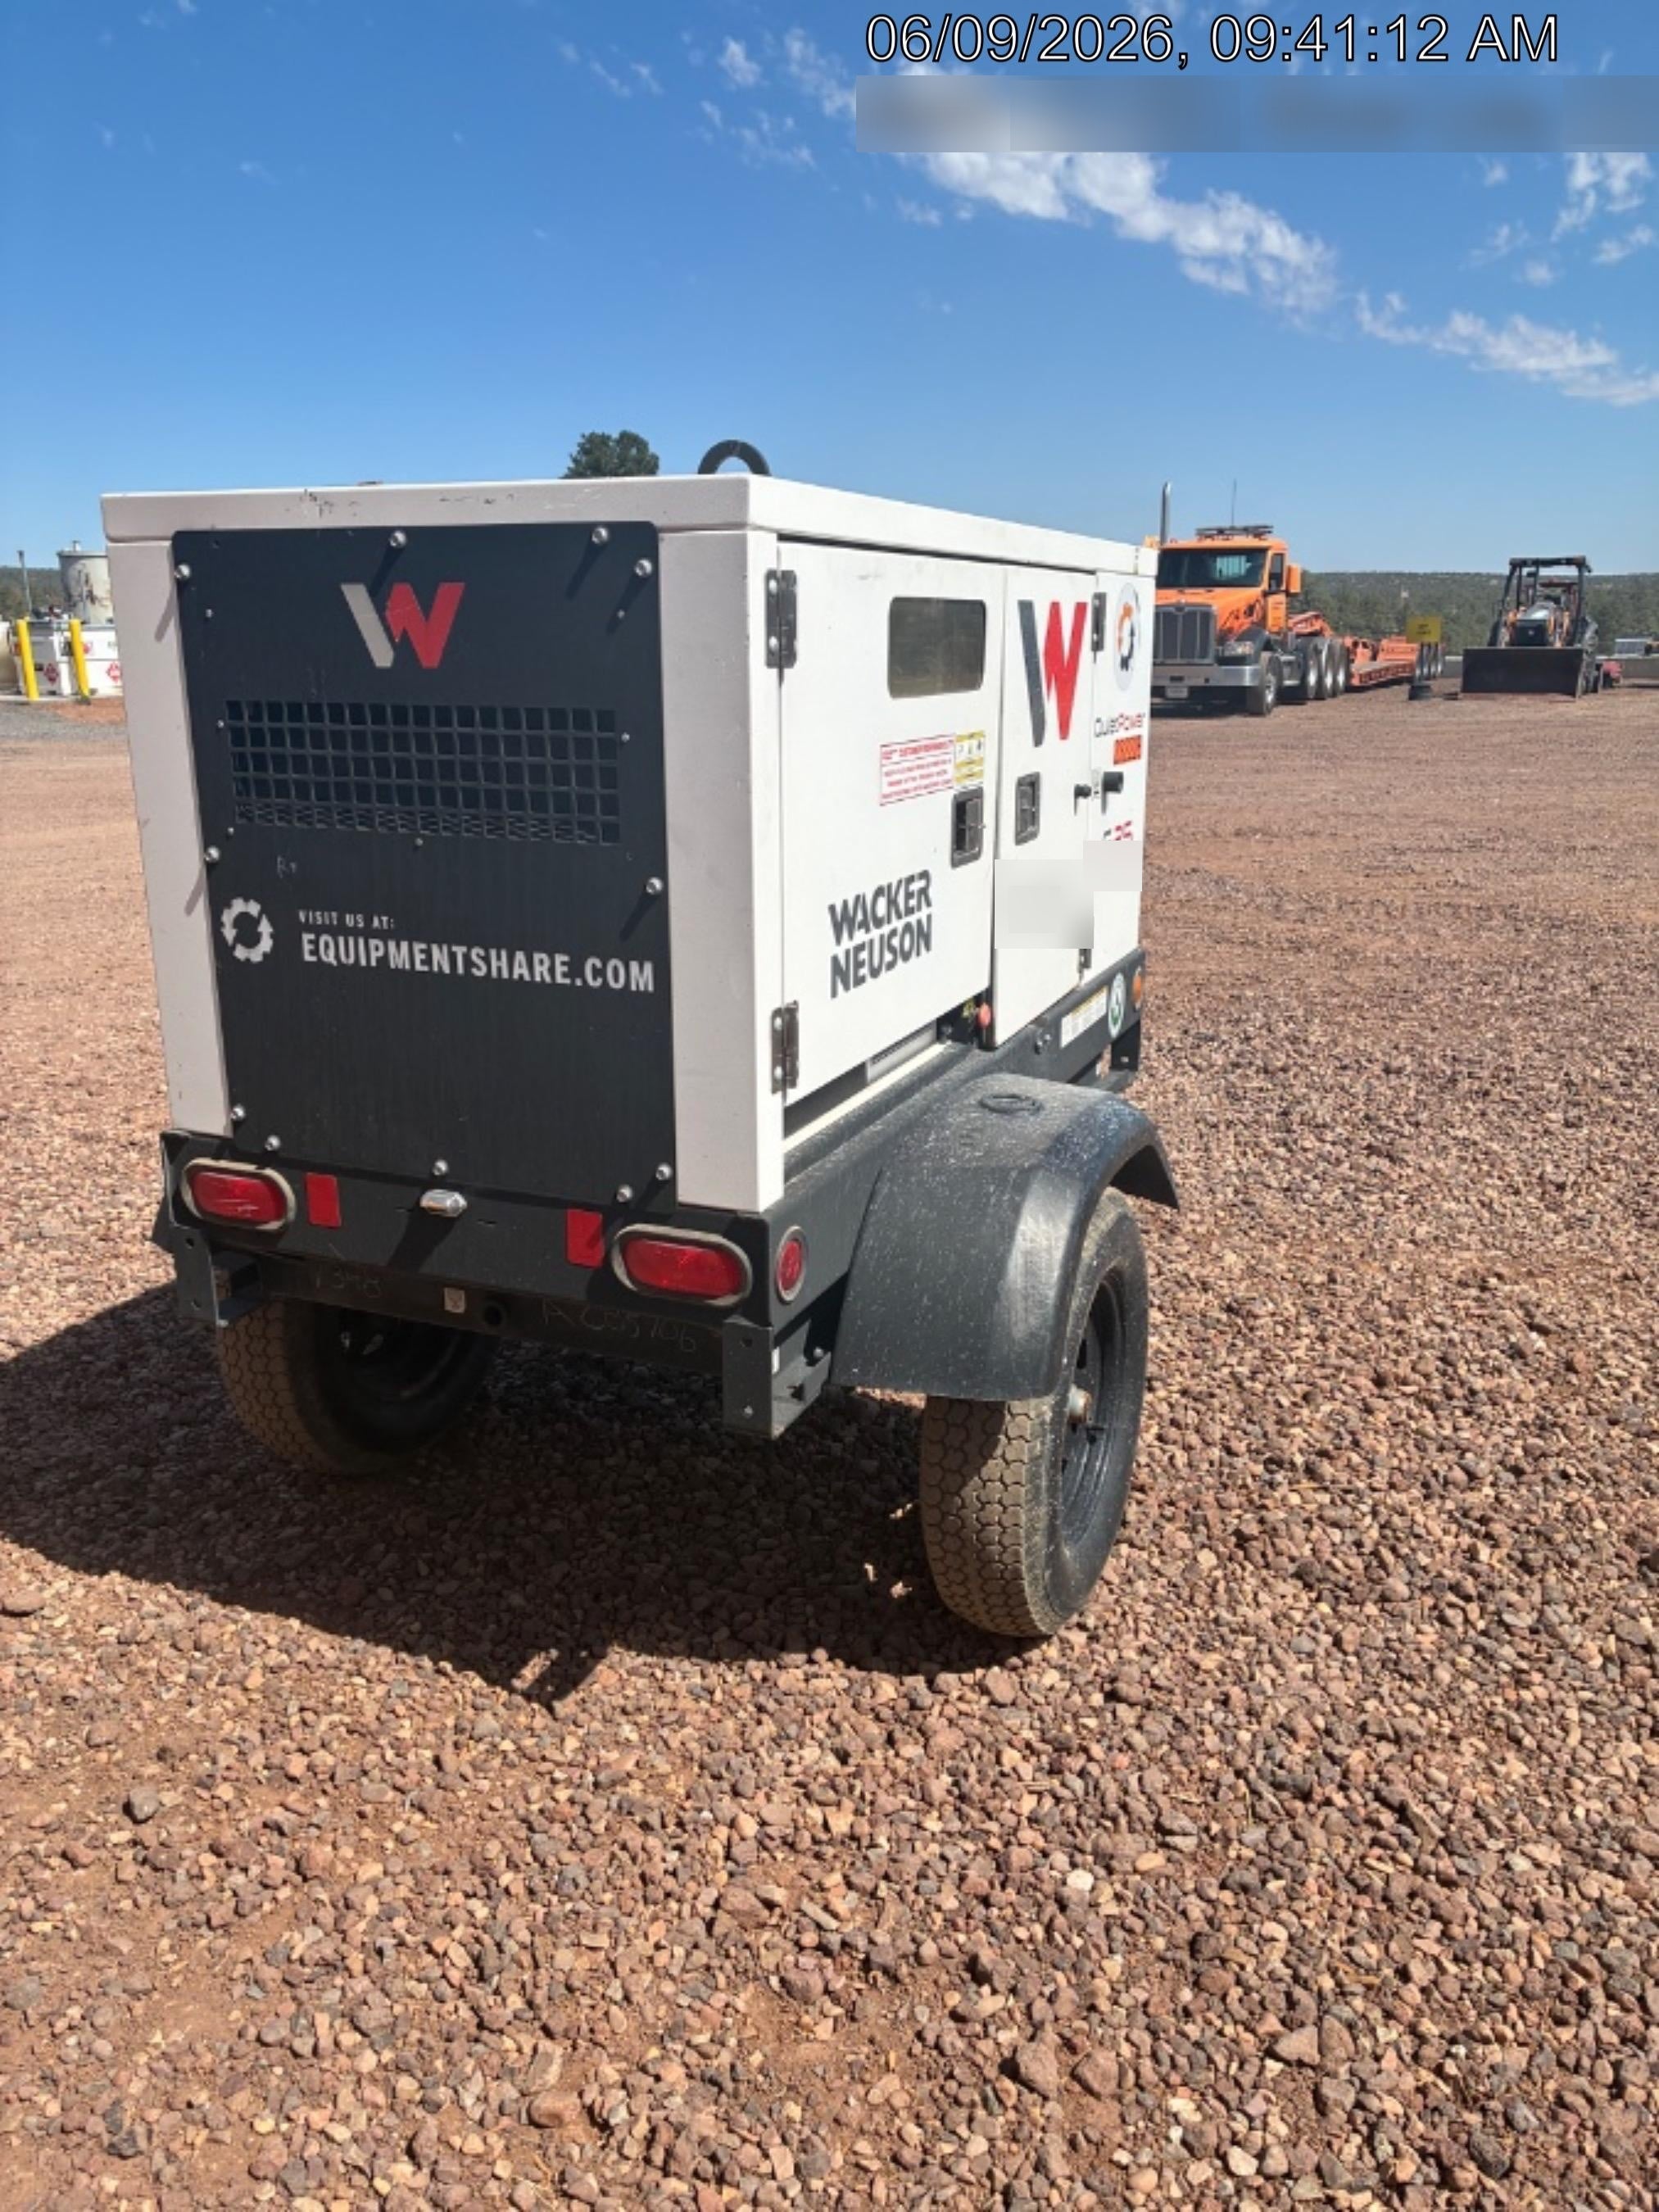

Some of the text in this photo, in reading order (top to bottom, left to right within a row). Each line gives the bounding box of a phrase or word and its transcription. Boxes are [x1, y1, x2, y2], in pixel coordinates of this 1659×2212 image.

[297, 909, 395, 930] VISIT US AT:
[828, 869, 932, 946] WACKER
[301, 931, 655, 993] EQUIPMENTSHARE.COM
[831, 913, 931, 999] NEUSON
